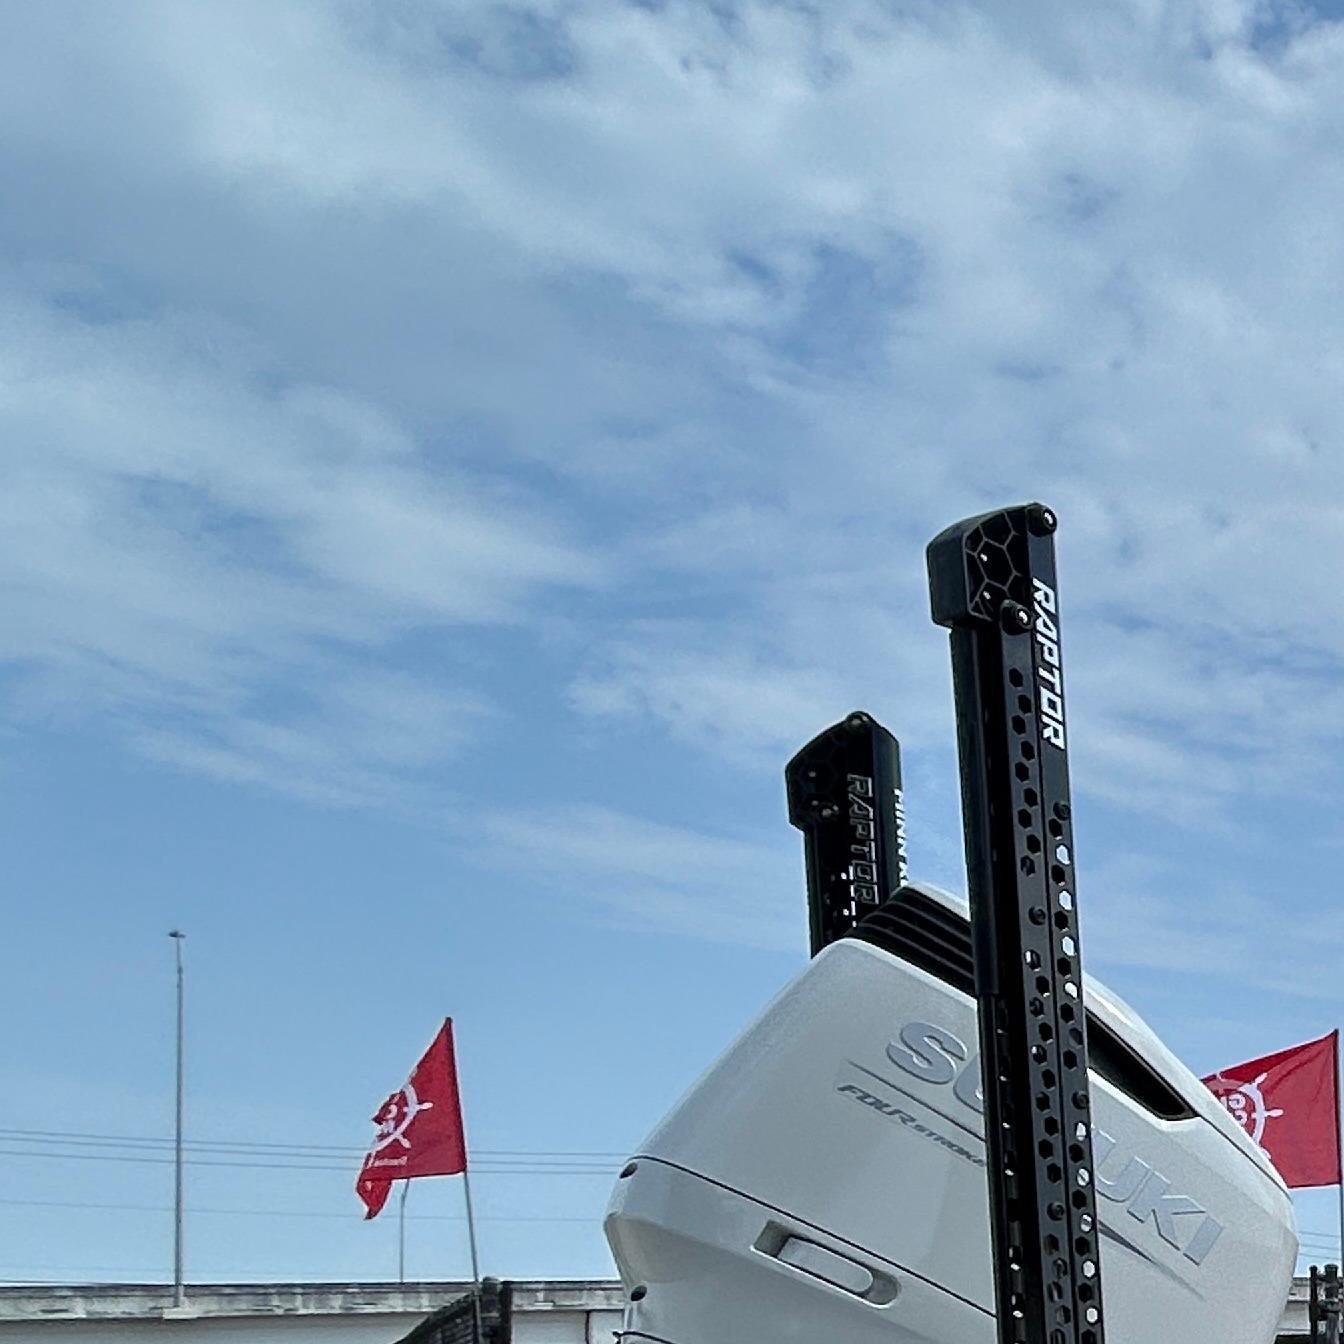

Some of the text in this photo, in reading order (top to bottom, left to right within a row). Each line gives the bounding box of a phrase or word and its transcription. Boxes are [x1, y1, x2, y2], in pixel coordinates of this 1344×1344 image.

[1032, 577, 1066, 750] RAPTOR
[847, 773, 879, 905] RAPTOR
[886, 1022, 1225, 1266] SUKI
